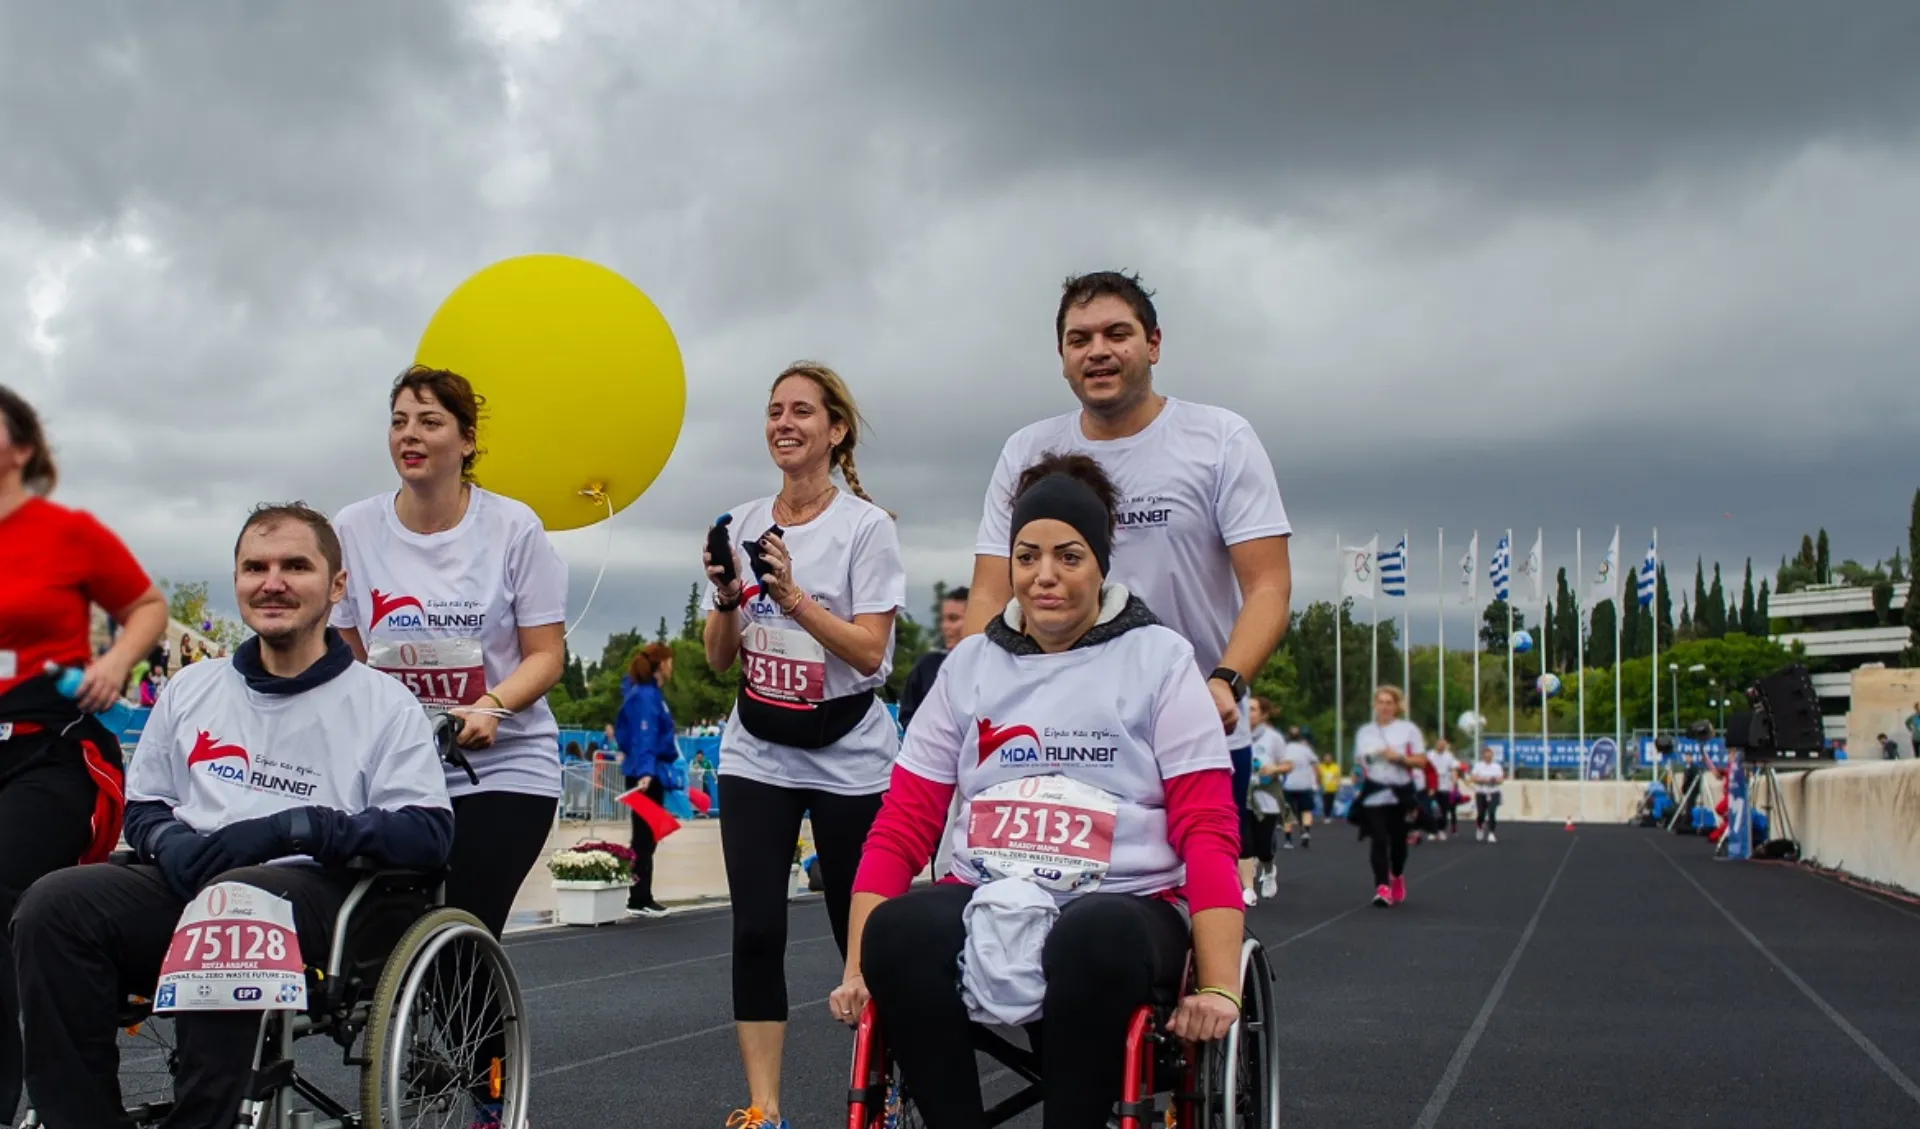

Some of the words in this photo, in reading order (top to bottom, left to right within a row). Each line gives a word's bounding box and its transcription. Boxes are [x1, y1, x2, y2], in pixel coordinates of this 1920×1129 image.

[388, 615, 422, 627] MDA
[747, 655, 807, 691] 75115
[388, 671, 469, 698] 5117
[1001, 747, 1038, 762] MDA
[208, 762, 245, 782] MDA
[991, 806, 1093, 849] 75132
[1054, 856, 1082, 865] FUTURE
[183, 925, 287, 960] 75128
[226, 971, 250, 979] WASTE
[252, 971, 279, 979] FUTURE
